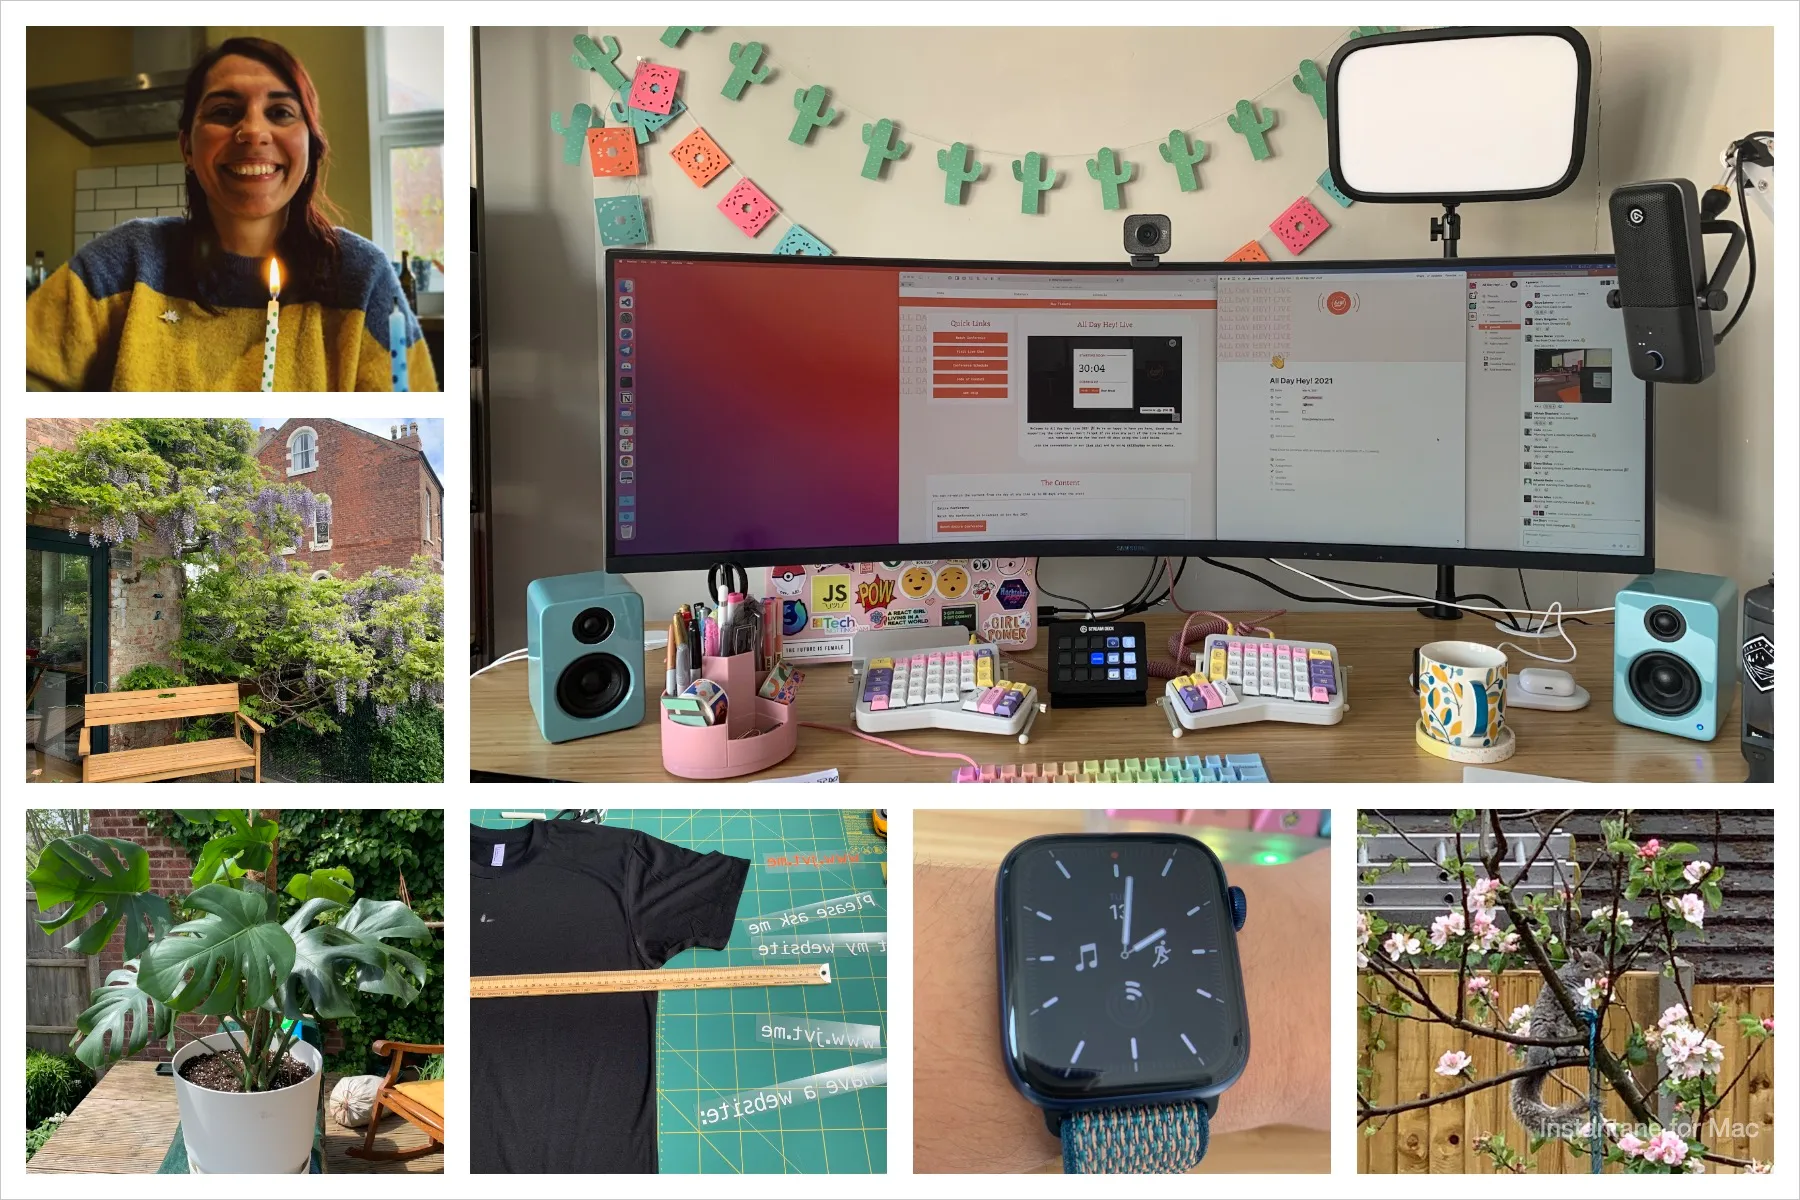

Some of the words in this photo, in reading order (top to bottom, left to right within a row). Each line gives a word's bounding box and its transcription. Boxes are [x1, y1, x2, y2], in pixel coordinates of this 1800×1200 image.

[950, 320, 971, 328] Quick
[972, 320, 991, 328] Links
[1088, 321, 1101, 330] Day
[1103, 321, 1117, 330] Hey!
[1079, 364, 1105, 373] 30:04
[1281, 378, 1295, 386] Day
[1296, 378, 1313, 386] Hey!
[823, 584, 847, 602] JS
[859, 579, 895, 606] POW
[823, 617, 855, 628] Tech
[992, 616, 1019, 629] GIRL
[988, 628, 1026, 641] POWER
